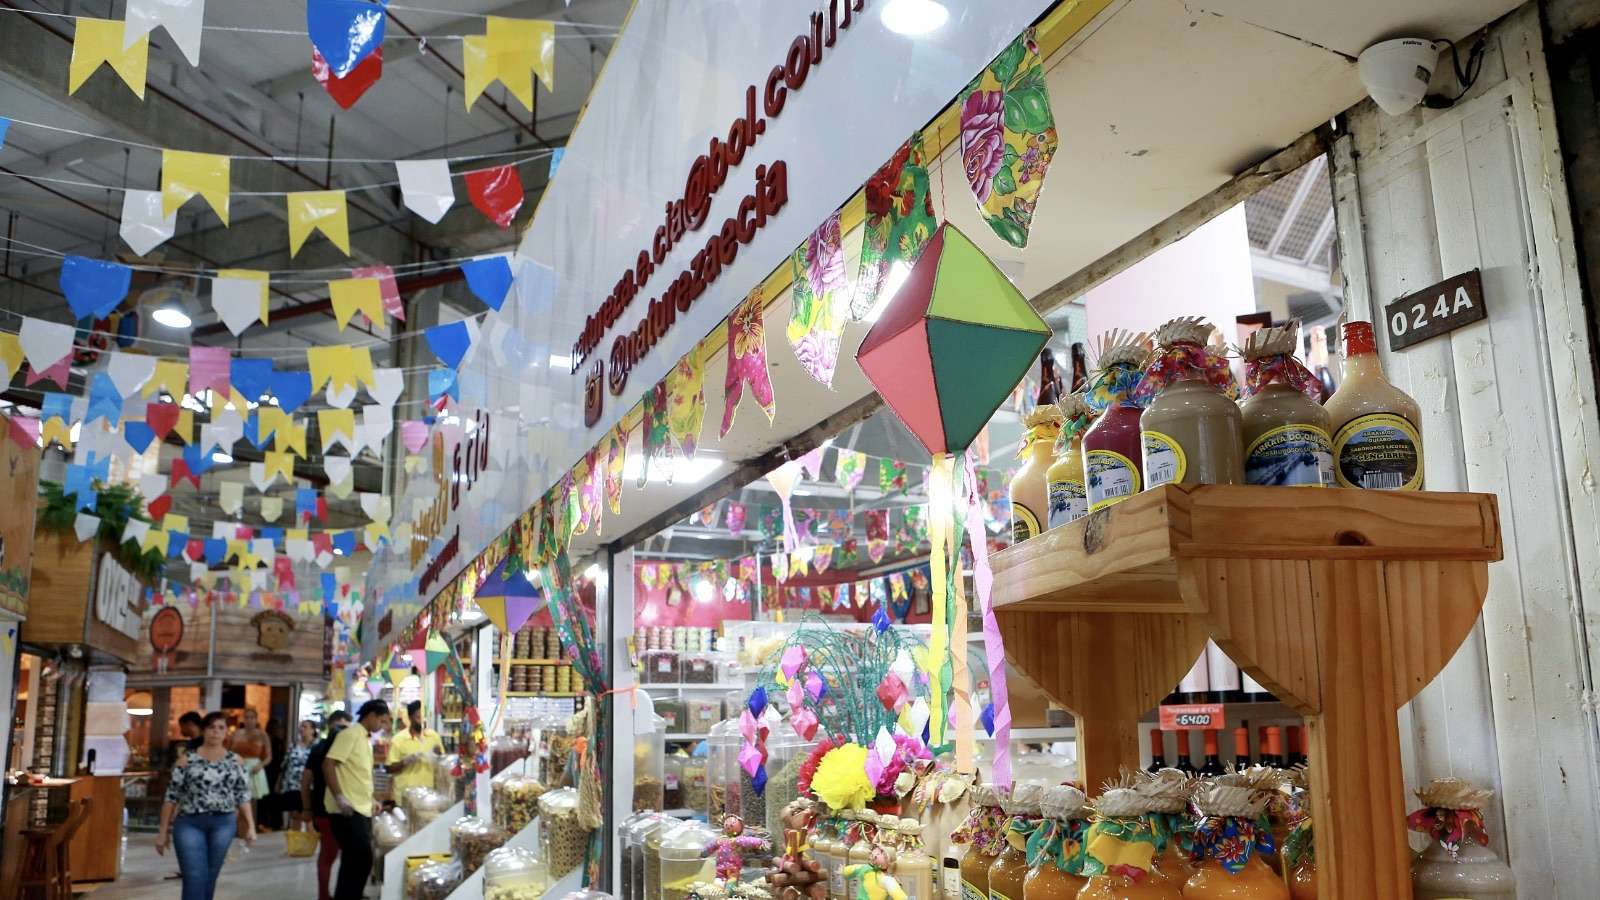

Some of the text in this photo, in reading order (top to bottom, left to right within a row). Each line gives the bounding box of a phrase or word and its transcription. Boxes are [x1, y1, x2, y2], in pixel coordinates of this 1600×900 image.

[608, 160, 789, 396] @naturezaecia
[1391, 286, 1474, 336] 024A
[1289, 433, 1303, 441] DO
